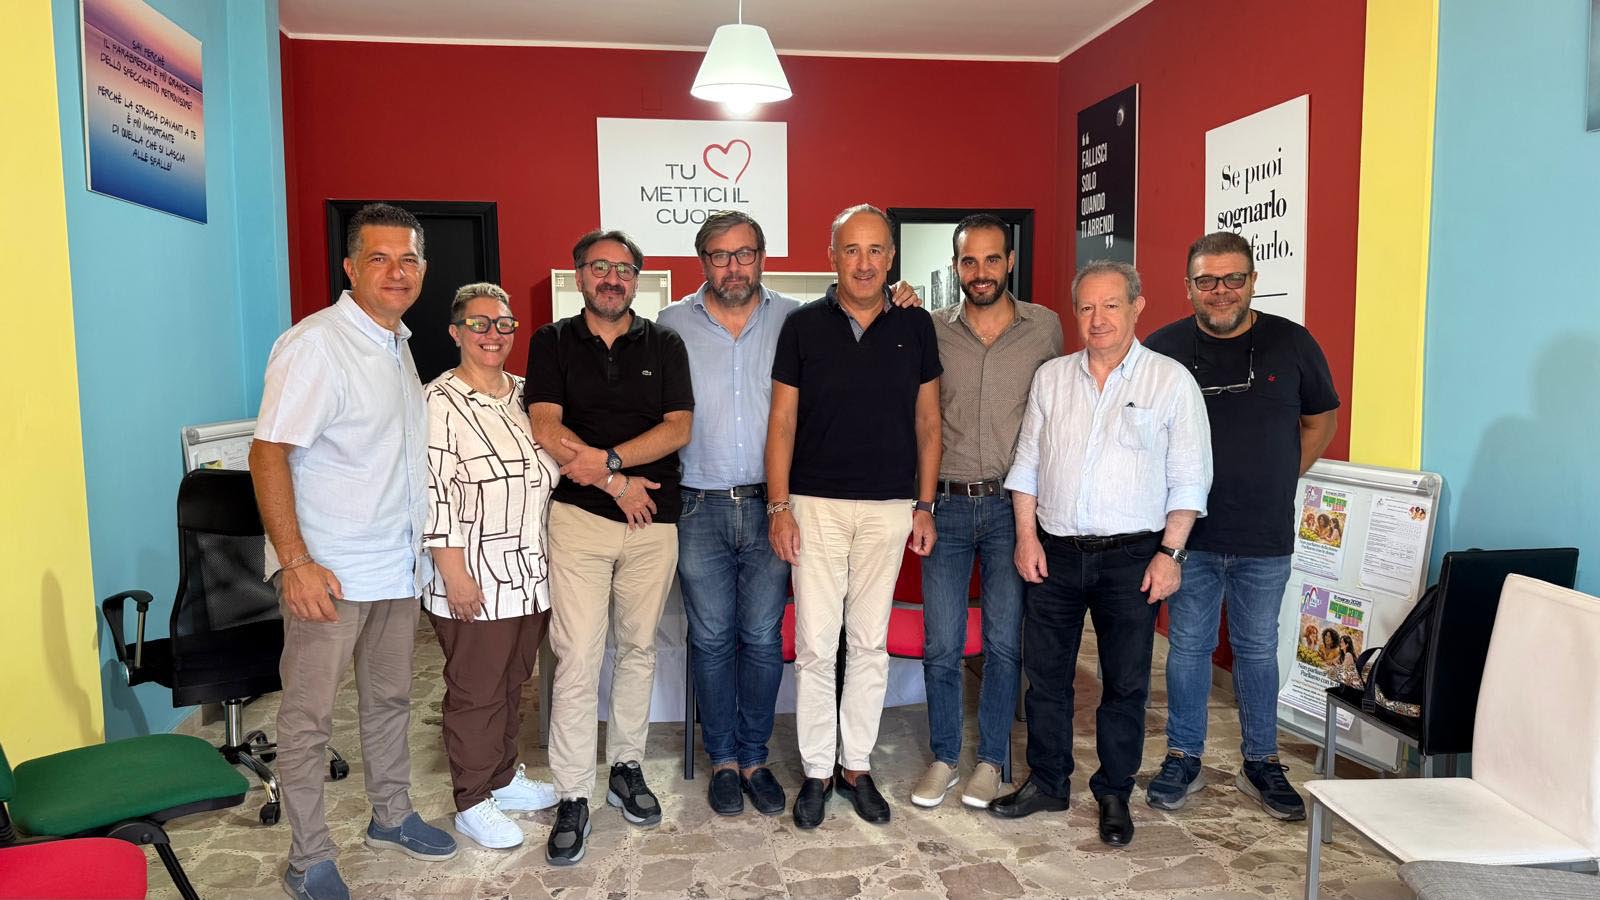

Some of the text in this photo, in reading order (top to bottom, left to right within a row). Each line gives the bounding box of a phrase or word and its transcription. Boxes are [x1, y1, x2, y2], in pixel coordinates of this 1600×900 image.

[100, 53, 121, 71] DELLO
[124, 98, 133, 109] LA
[135, 104, 159, 122] STRADA
[160, 116, 183, 134] DAVANTI
[190, 130, 197, 140] TE
[112, 124, 119, 134] DI
[121, 127, 144, 145] QUELLA
[145, 139, 157, 151] CHE
[165, 147, 186, 163] LASCIA
[143, 122, 175, 144] IMPORTANTE
[132, 149, 148, 162] ALLE
[1081, 142, 1108, 170] FALLISCI
[665, 163, 697, 180] TU
[1081, 171, 1097, 193] SOLO
[1221, 147, 1282, 194] Se puoi
[640, 186, 749, 204] METTICI IL
[1081, 192, 1106, 216] QUANDO
[1217, 189, 1287, 235] sognarlo
[1081, 213, 1114, 238] TI ARRENDI
